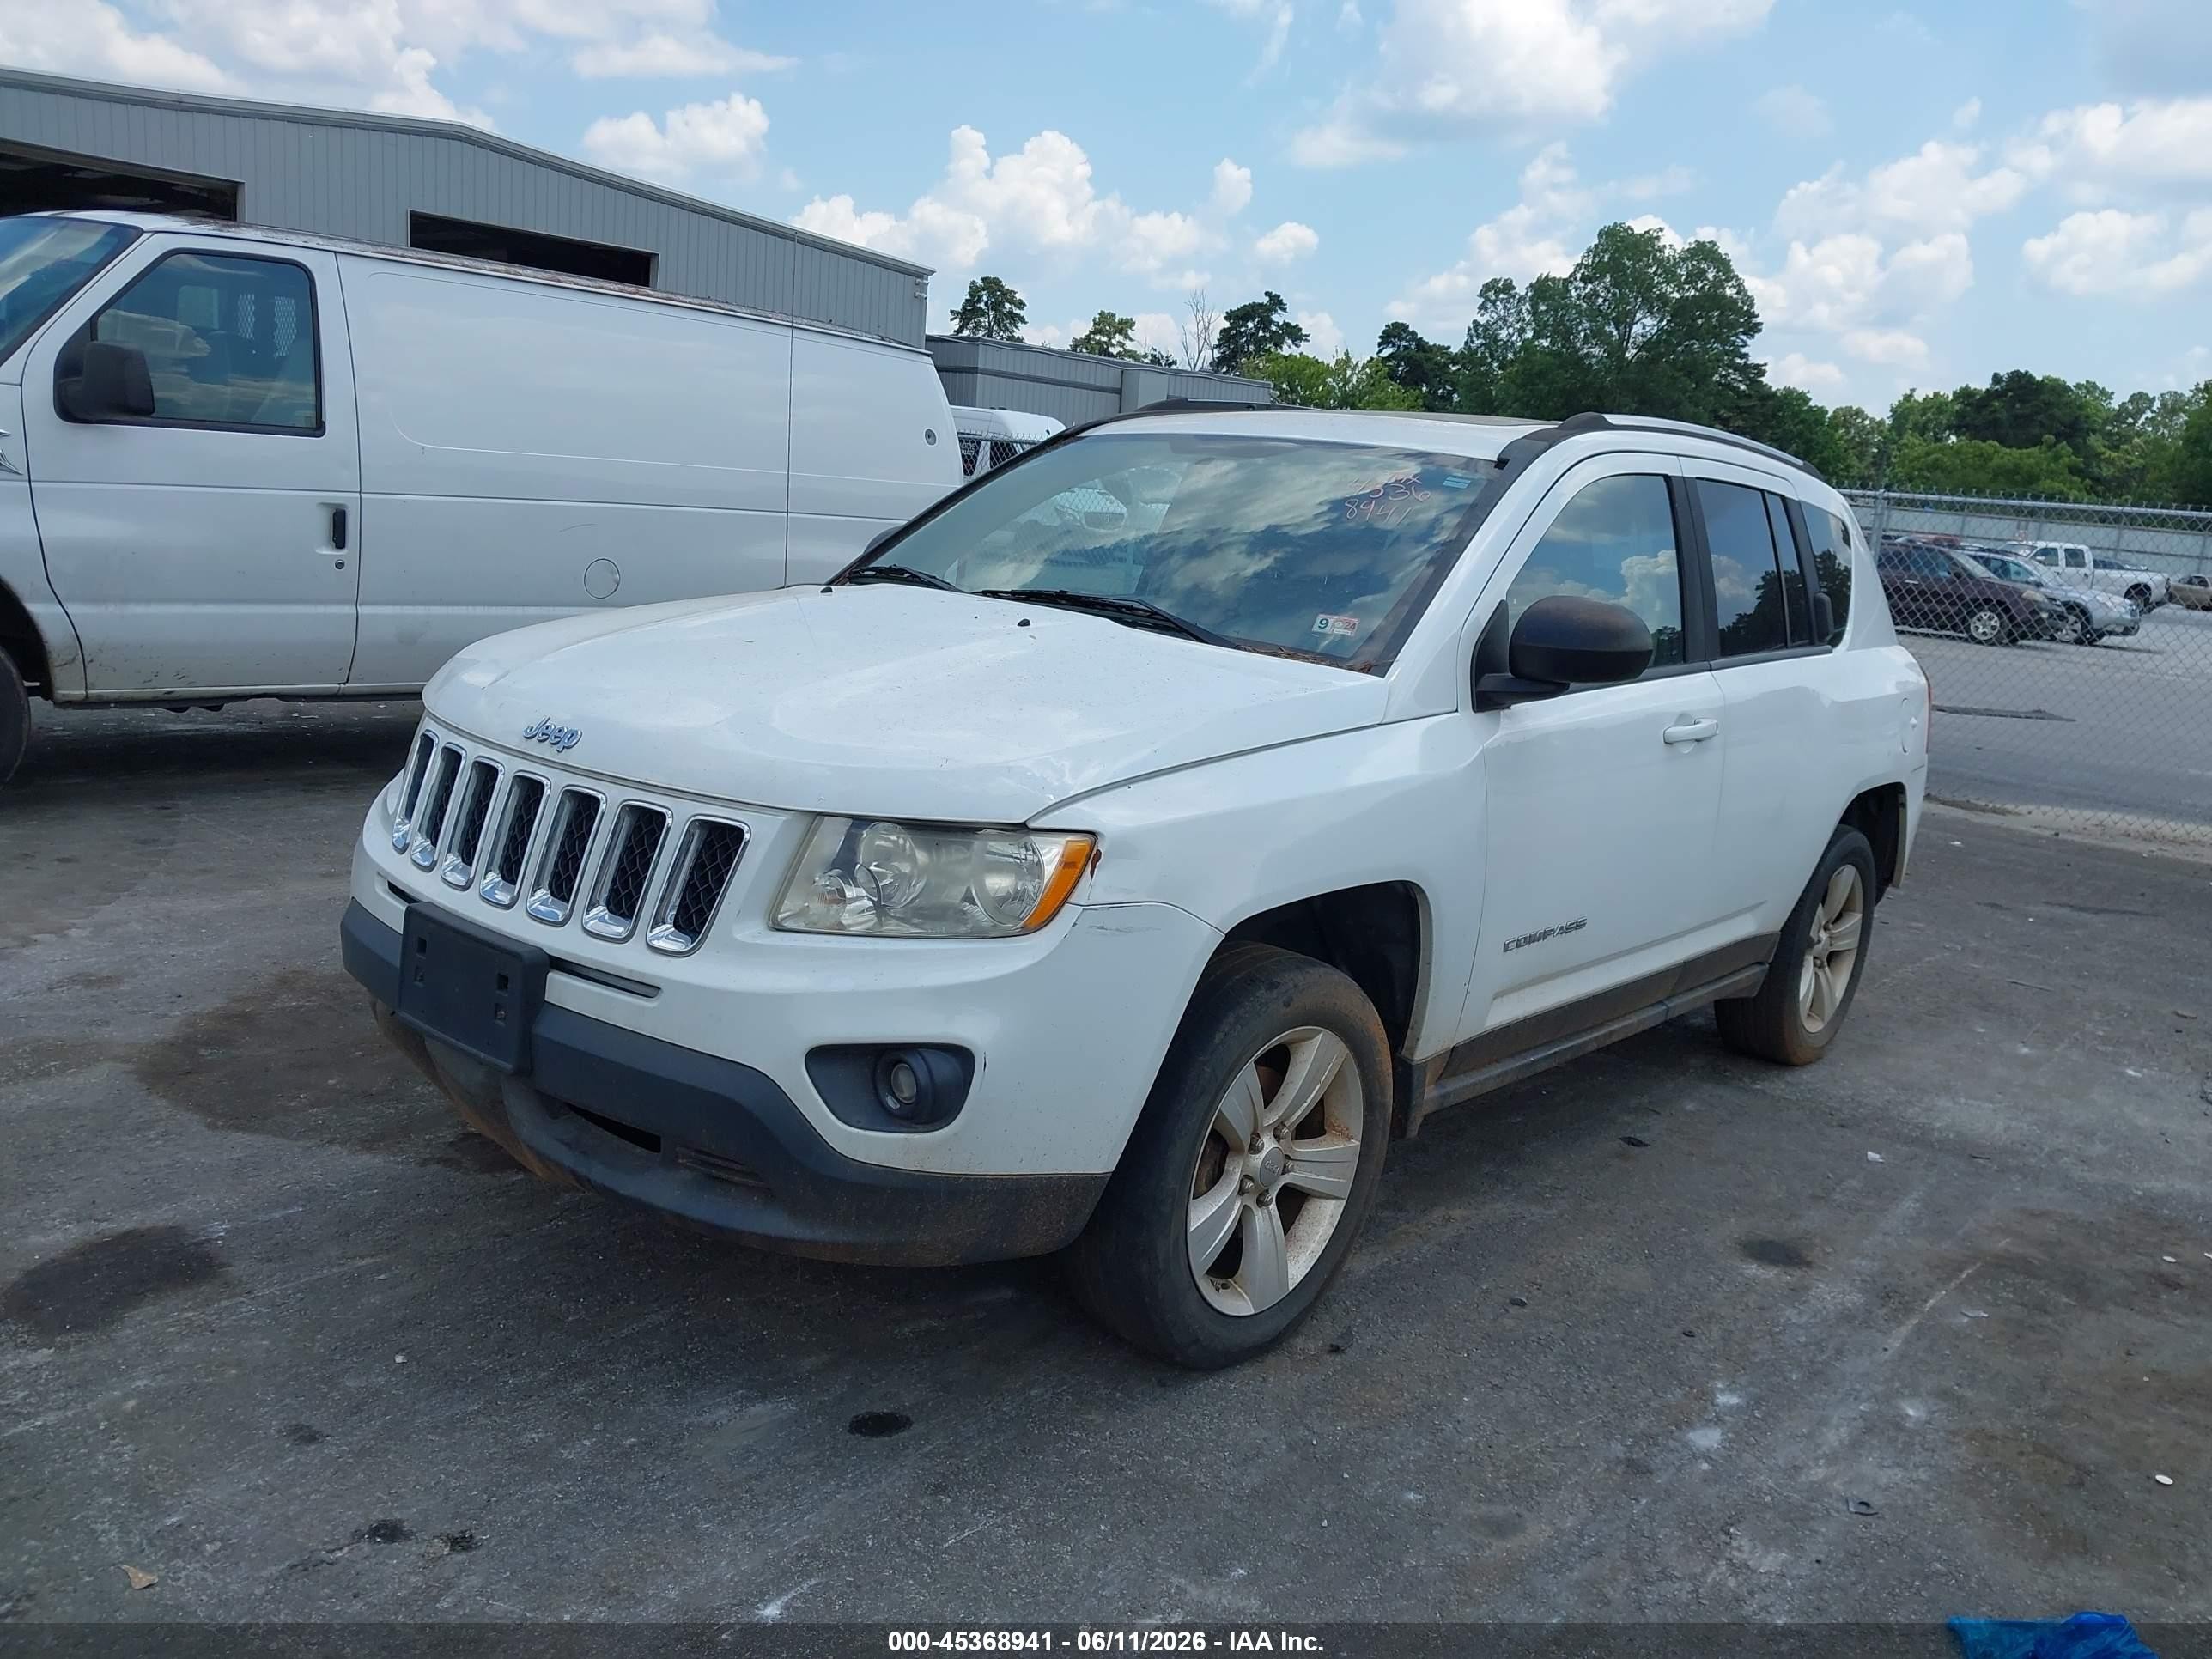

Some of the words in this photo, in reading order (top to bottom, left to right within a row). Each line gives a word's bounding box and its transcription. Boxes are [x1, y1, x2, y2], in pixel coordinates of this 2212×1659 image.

[1318, 618, 1329, 629] 9
[523, 715, 582, 753] Jeep
[1503, 915, 1588, 953] COMPASS
